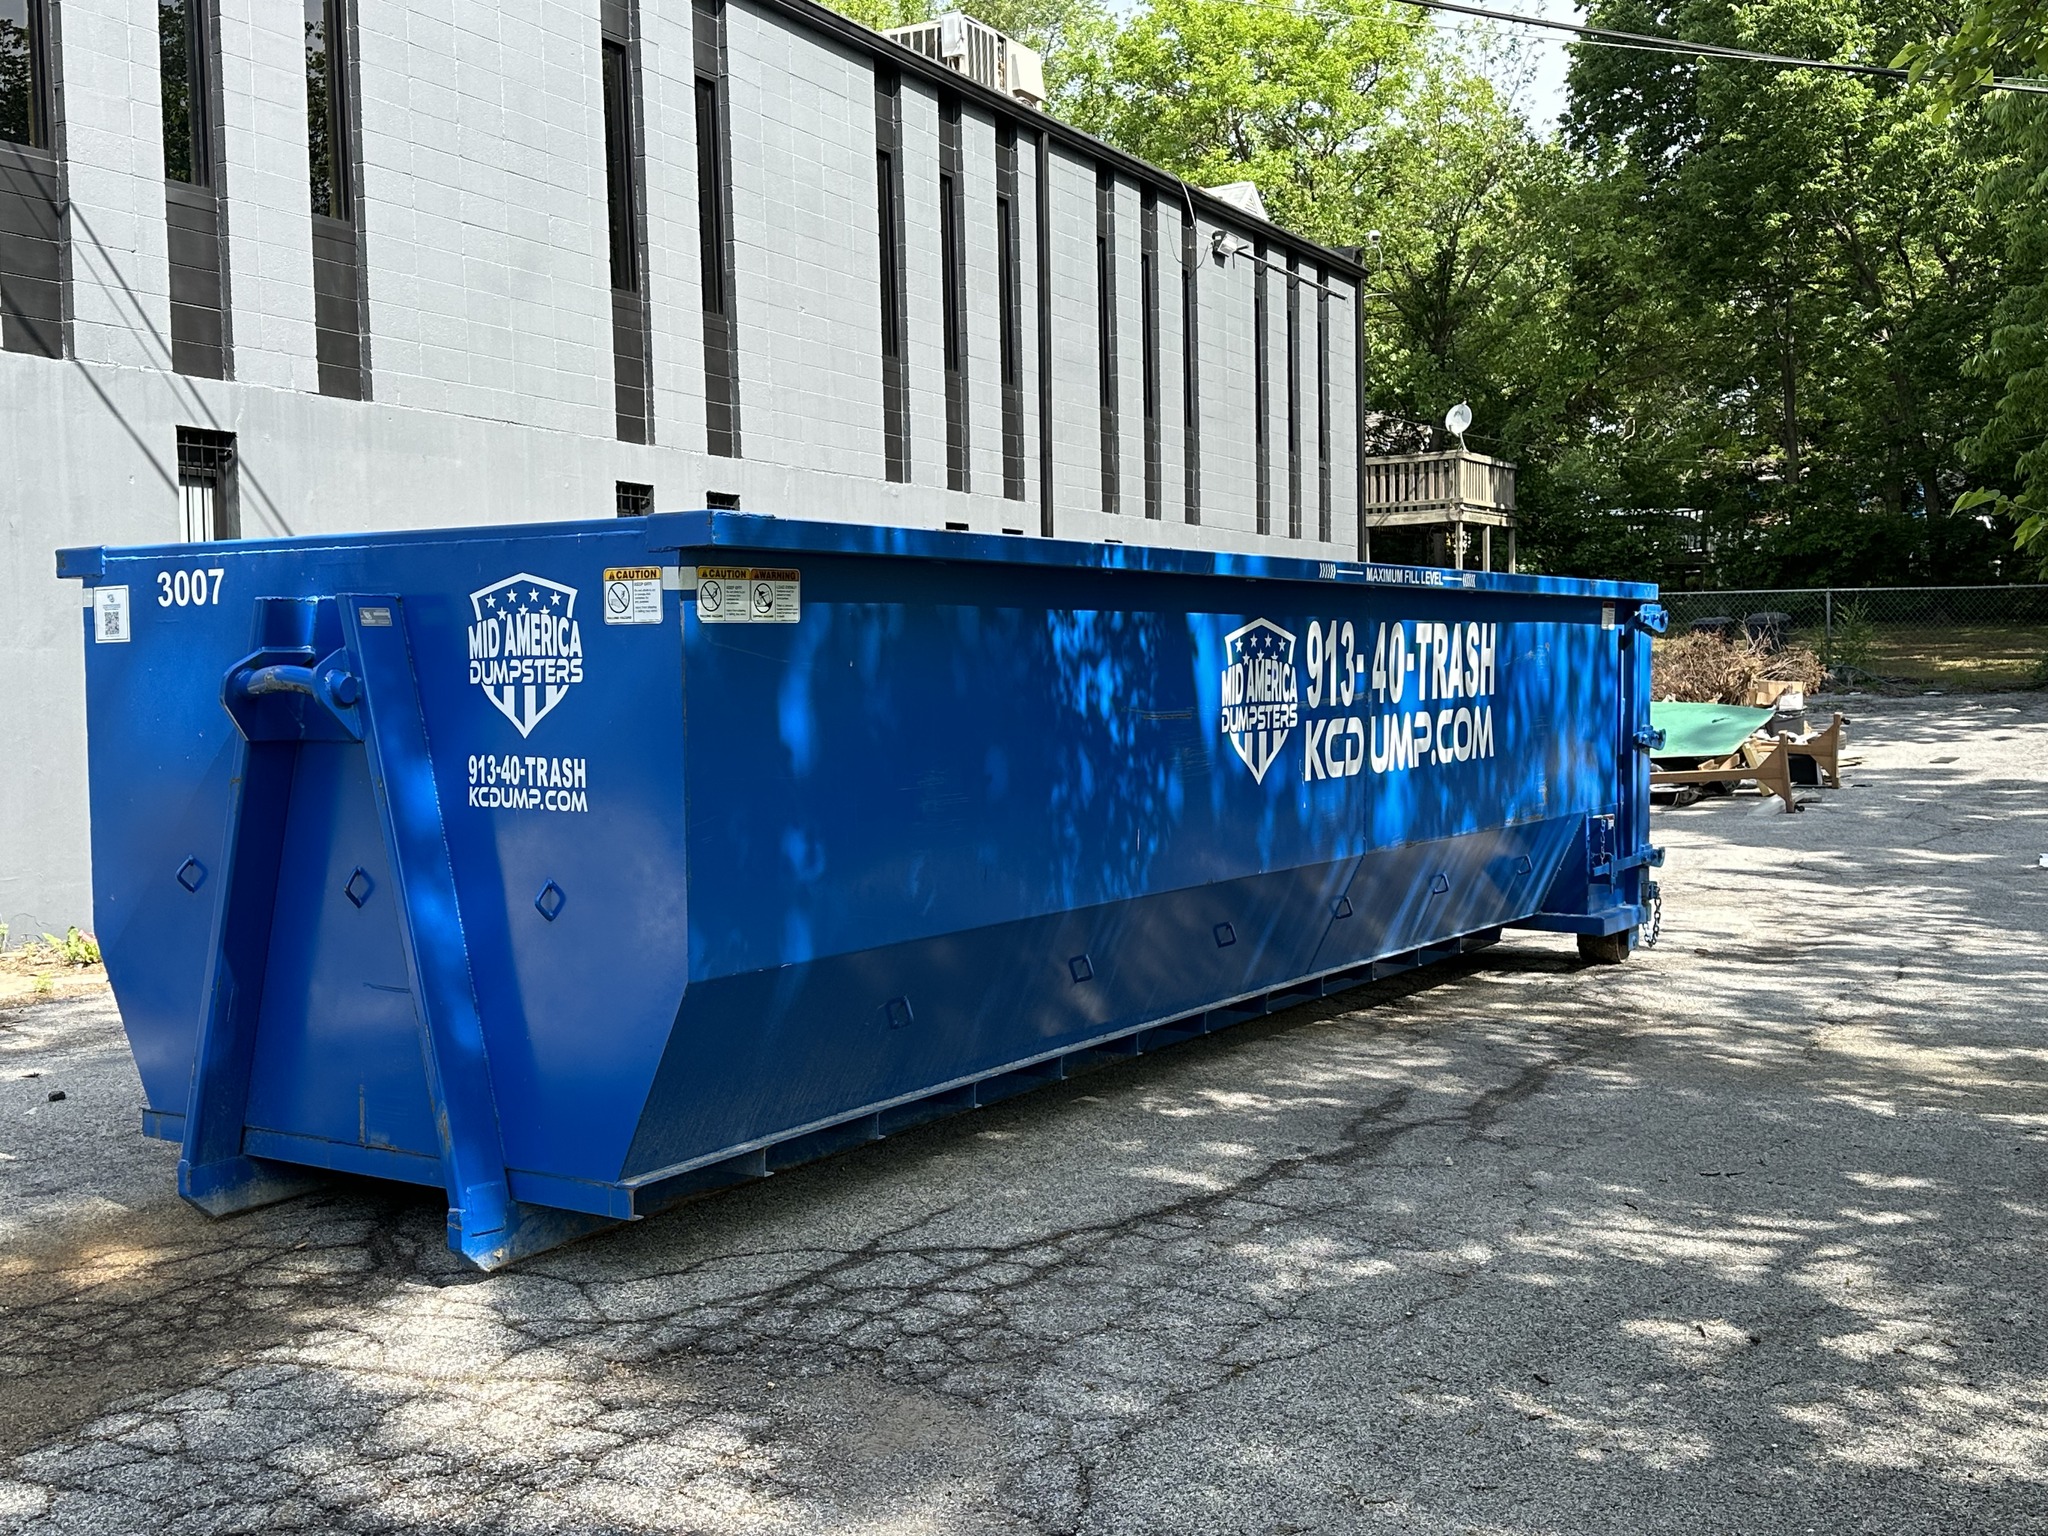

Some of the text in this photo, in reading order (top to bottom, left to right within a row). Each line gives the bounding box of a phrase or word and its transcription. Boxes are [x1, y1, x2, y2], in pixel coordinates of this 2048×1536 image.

[157, 568, 225, 607] 3007
[616, 569, 657, 579] CAUTION
[708, 569, 747, 579] CAUTION
[759, 571, 796, 580] WARNING
[1366, 567, 1444, 585] MAXIMUM FILL LEVEL
[468, 612, 583, 660] MID AMERICA
[469, 658, 584, 685] DUMPSTERS
[1221, 658, 1298, 707] MID AMERICA
[1221, 703, 1298, 733] DUMPSTERS
[468, 754, 587, 789] 913-40-TRASH
[469, 786, 589, 812] KCDUMP.COM
